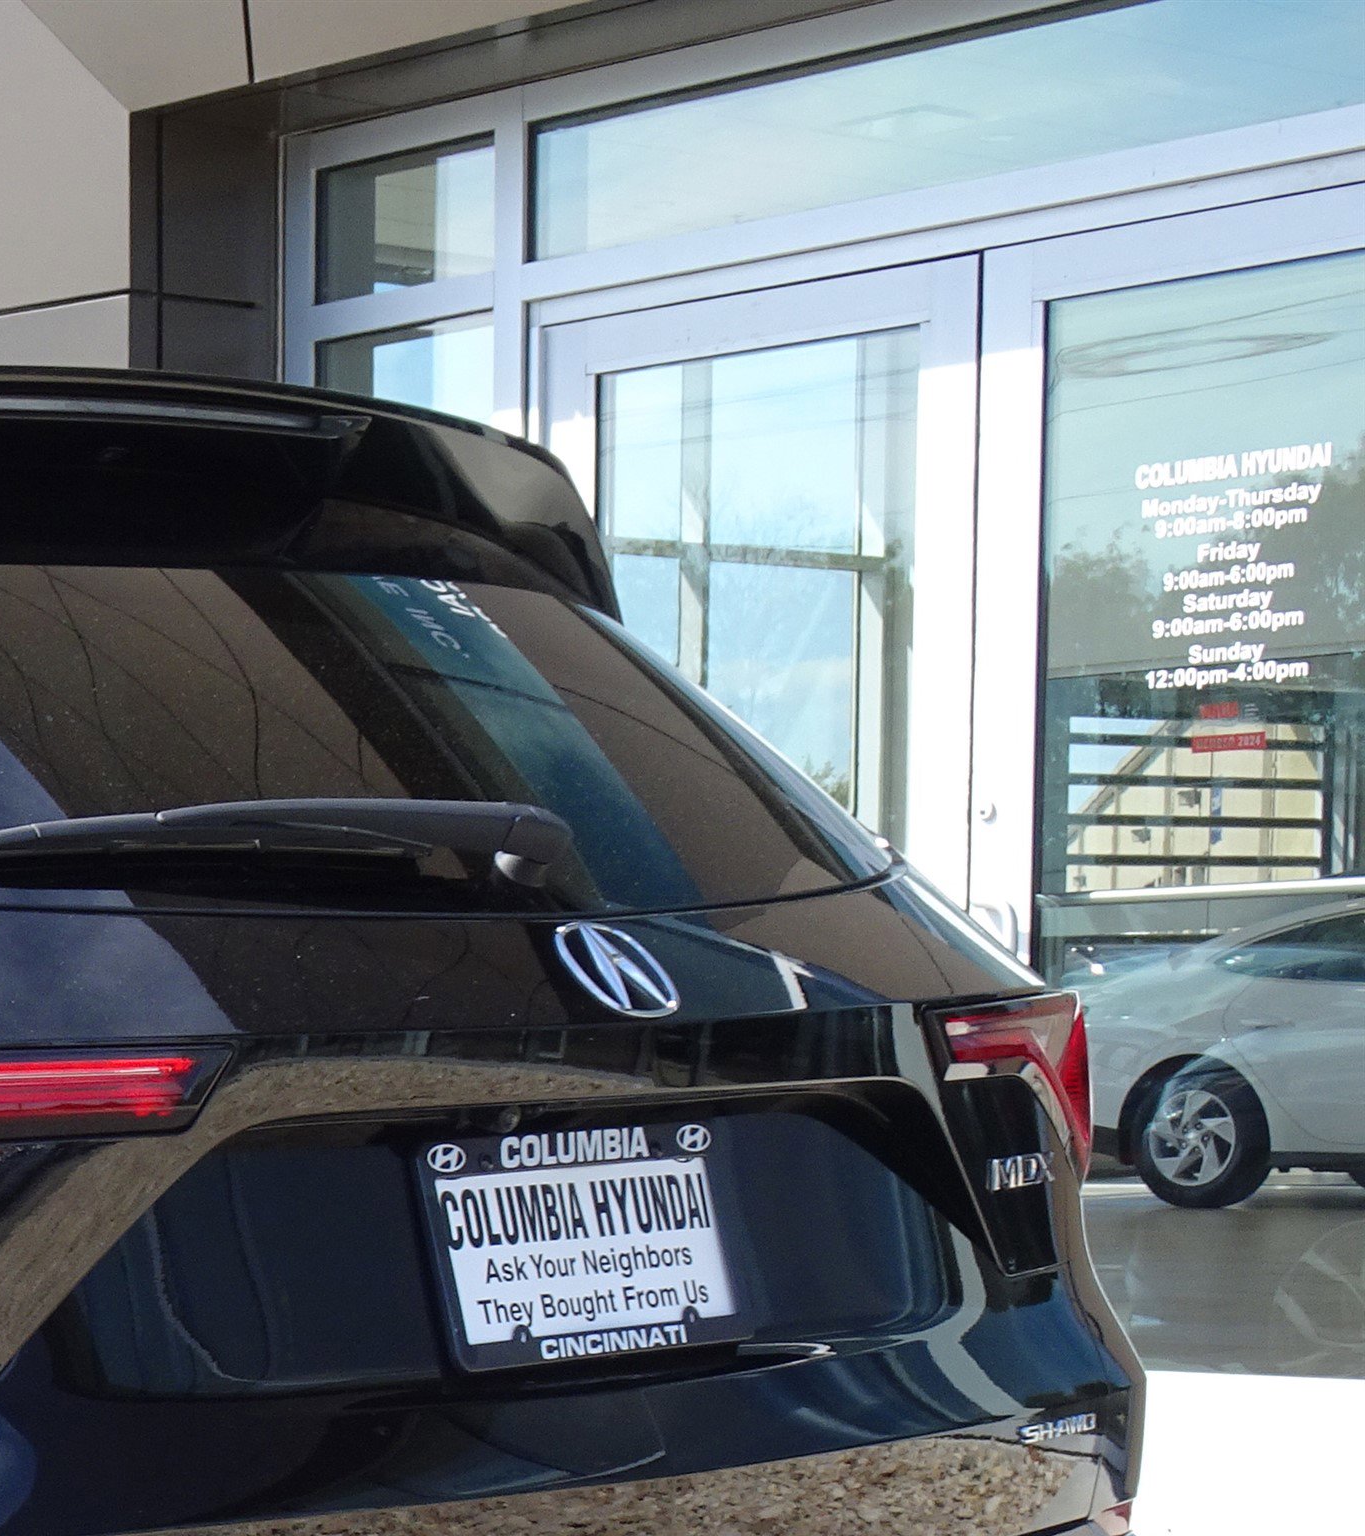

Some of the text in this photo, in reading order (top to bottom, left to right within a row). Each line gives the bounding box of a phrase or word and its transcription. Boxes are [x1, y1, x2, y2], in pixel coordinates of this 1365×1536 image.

[1135, 442, 1332, 489] COLUMBIA HYUNDAI
[1141, 482, 1322, 518] Monday-Thursday
[1197, 541, 1261, 563] Friday
[1162, 562, 1295, 592] 9:00am-6:00pm
[1182, 589, 1273, 613] Saturday
[1152, 610, 1304, 639] 9:00am-6:00pm
[1188, 641, 1265, 664] Sunday
[1145, 660, 1310, 690] 12:00pm-4:00pm
[499, 1127, 650, 1168] COLUMBIA
[440, 1172, 711, 1251] COLUMBIA HYUNDAI
[485, 1245, 693, 1285] Ask Your Neighbors
[477, 1279, 709, 1328] They Bought From Us
[540, 1324, 689, 1360] CINCINNATI
